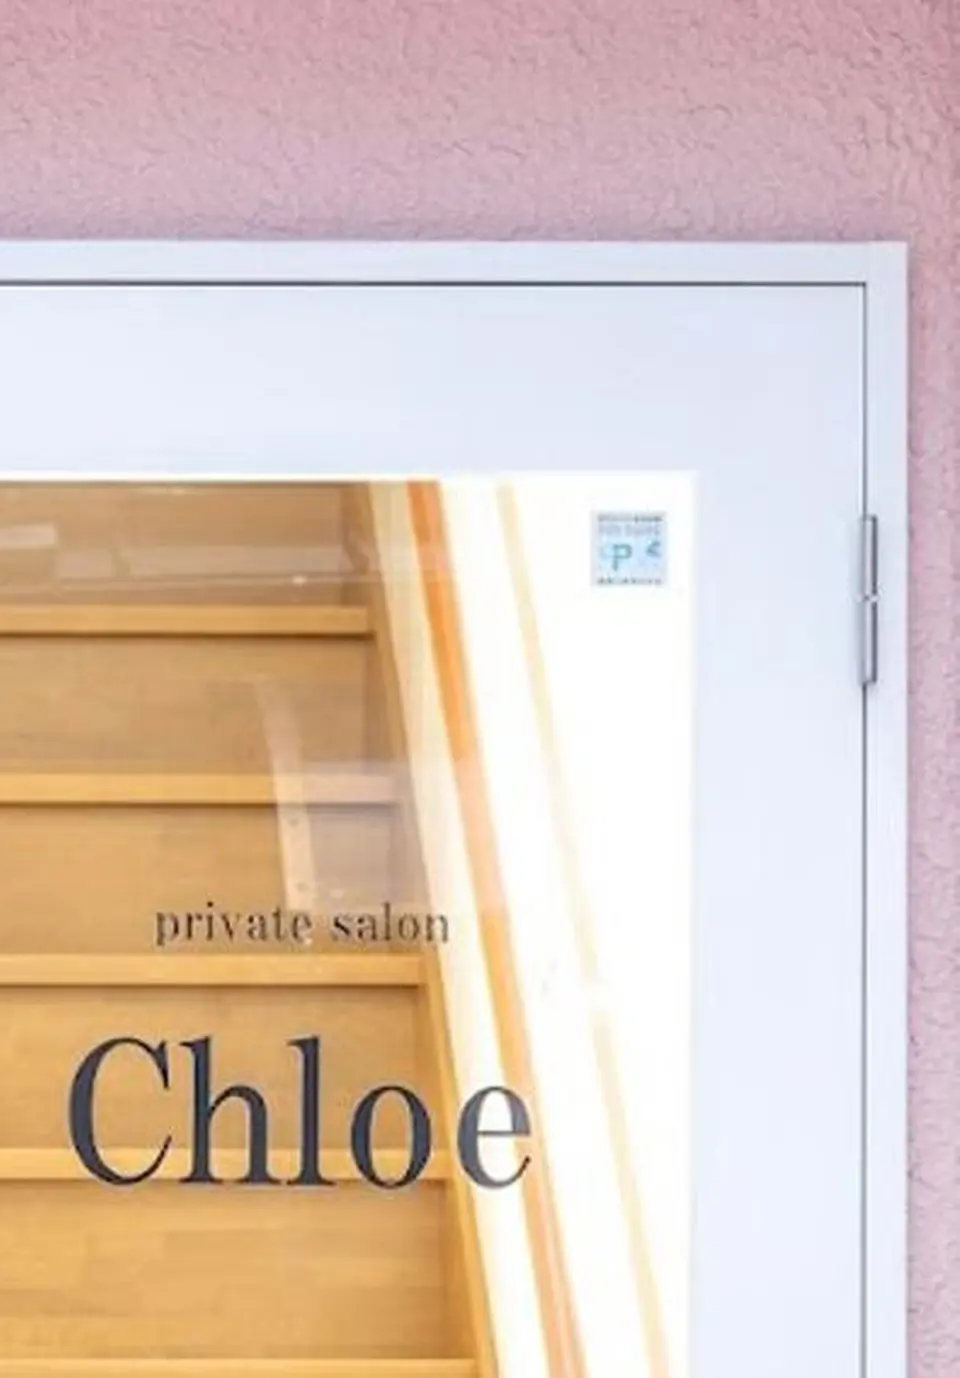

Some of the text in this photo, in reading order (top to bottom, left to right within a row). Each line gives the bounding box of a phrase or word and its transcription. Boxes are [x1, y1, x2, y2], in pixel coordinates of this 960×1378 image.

[156, 902, 449, 945] private salon
[68, 1036, 530, 1189] Chloe
